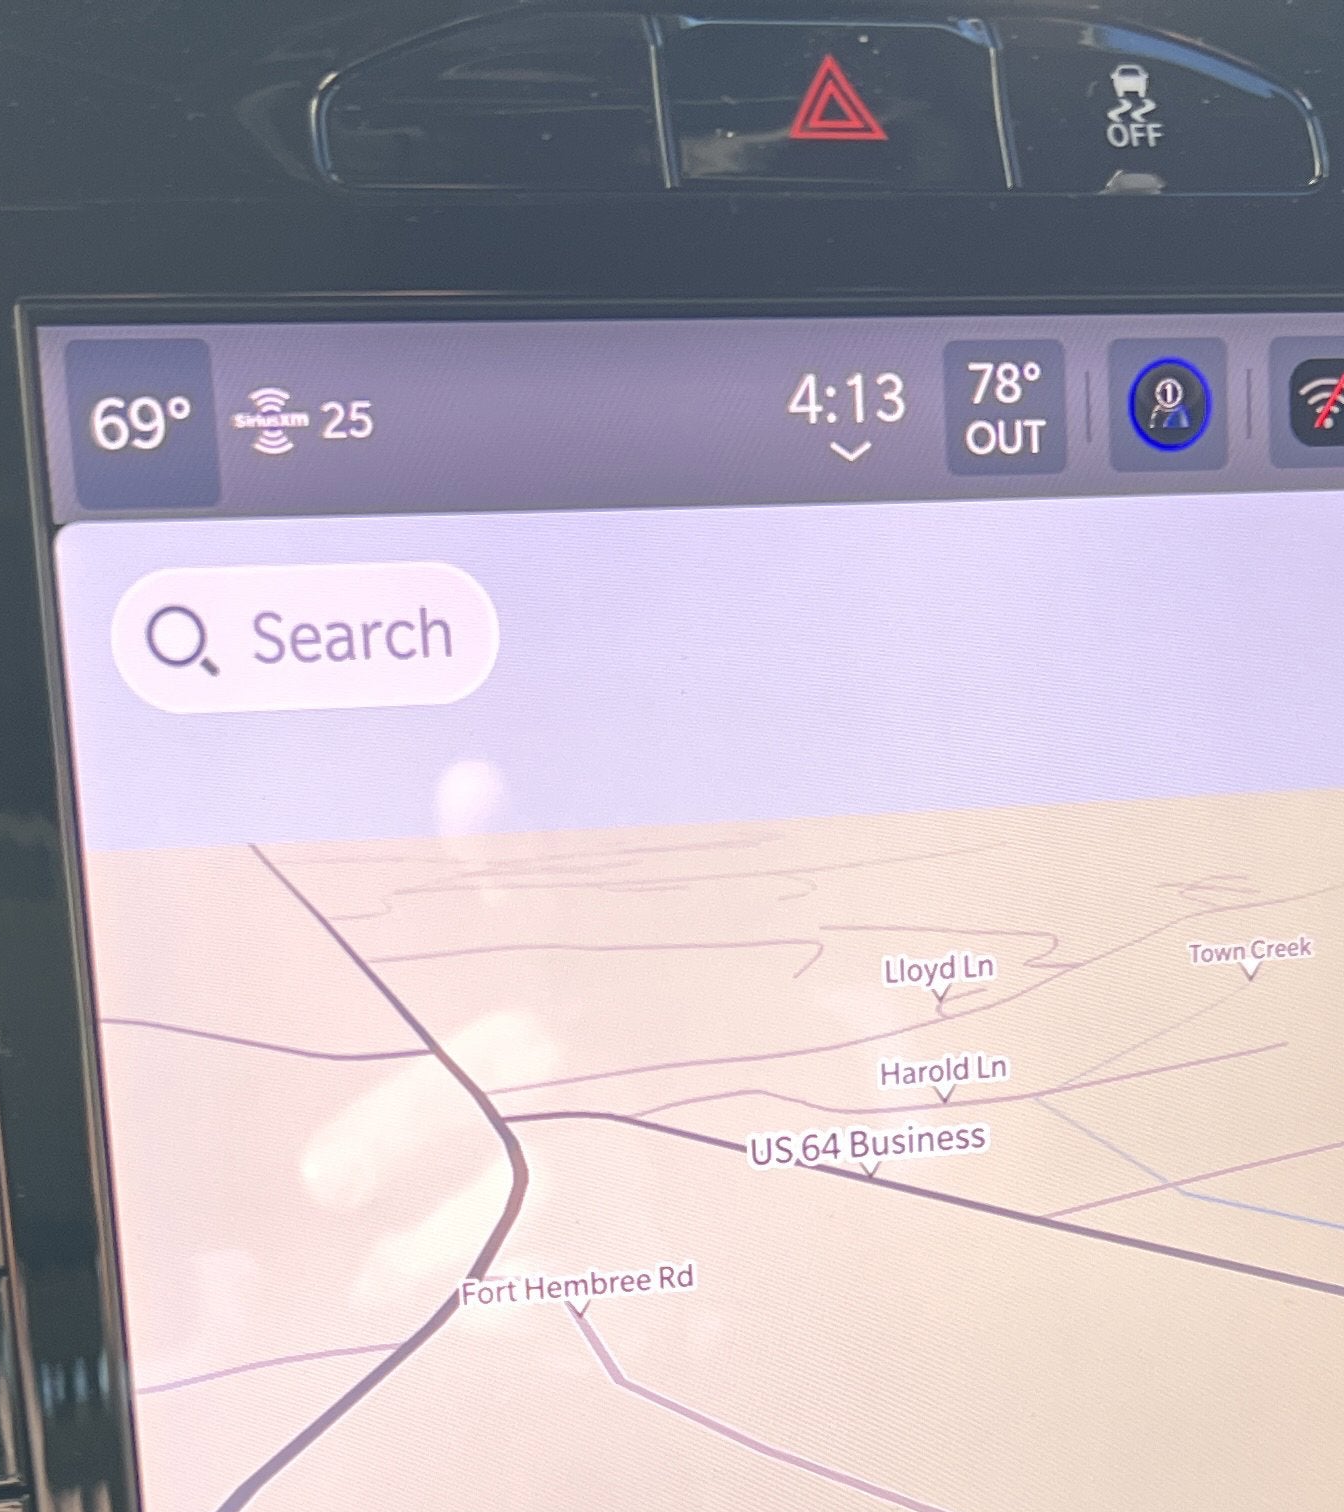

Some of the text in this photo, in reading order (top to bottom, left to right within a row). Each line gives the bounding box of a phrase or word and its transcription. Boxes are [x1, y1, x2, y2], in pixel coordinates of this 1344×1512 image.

[1106, 124, 1163, 148] OFF
[787, 373, 906, 424] 4:13
[967, 362, 1040, 404] 78°
[91, 396, 191, 450] 69°
[320, 400, 373, 439] 25
[965, 419, 1046, 455] OUT
[253, 605, 454, 664] Search
[884, 954, 994, 984] Lloyd Ln
[1188, 937, 1312, 964] Town Creek
[881, 1056, 1006, 1085] Harold Ln
[751, 1125, 985, 1165] US 64 Business
[462, 1264, 693, 1305] Fort Hembree Rd
